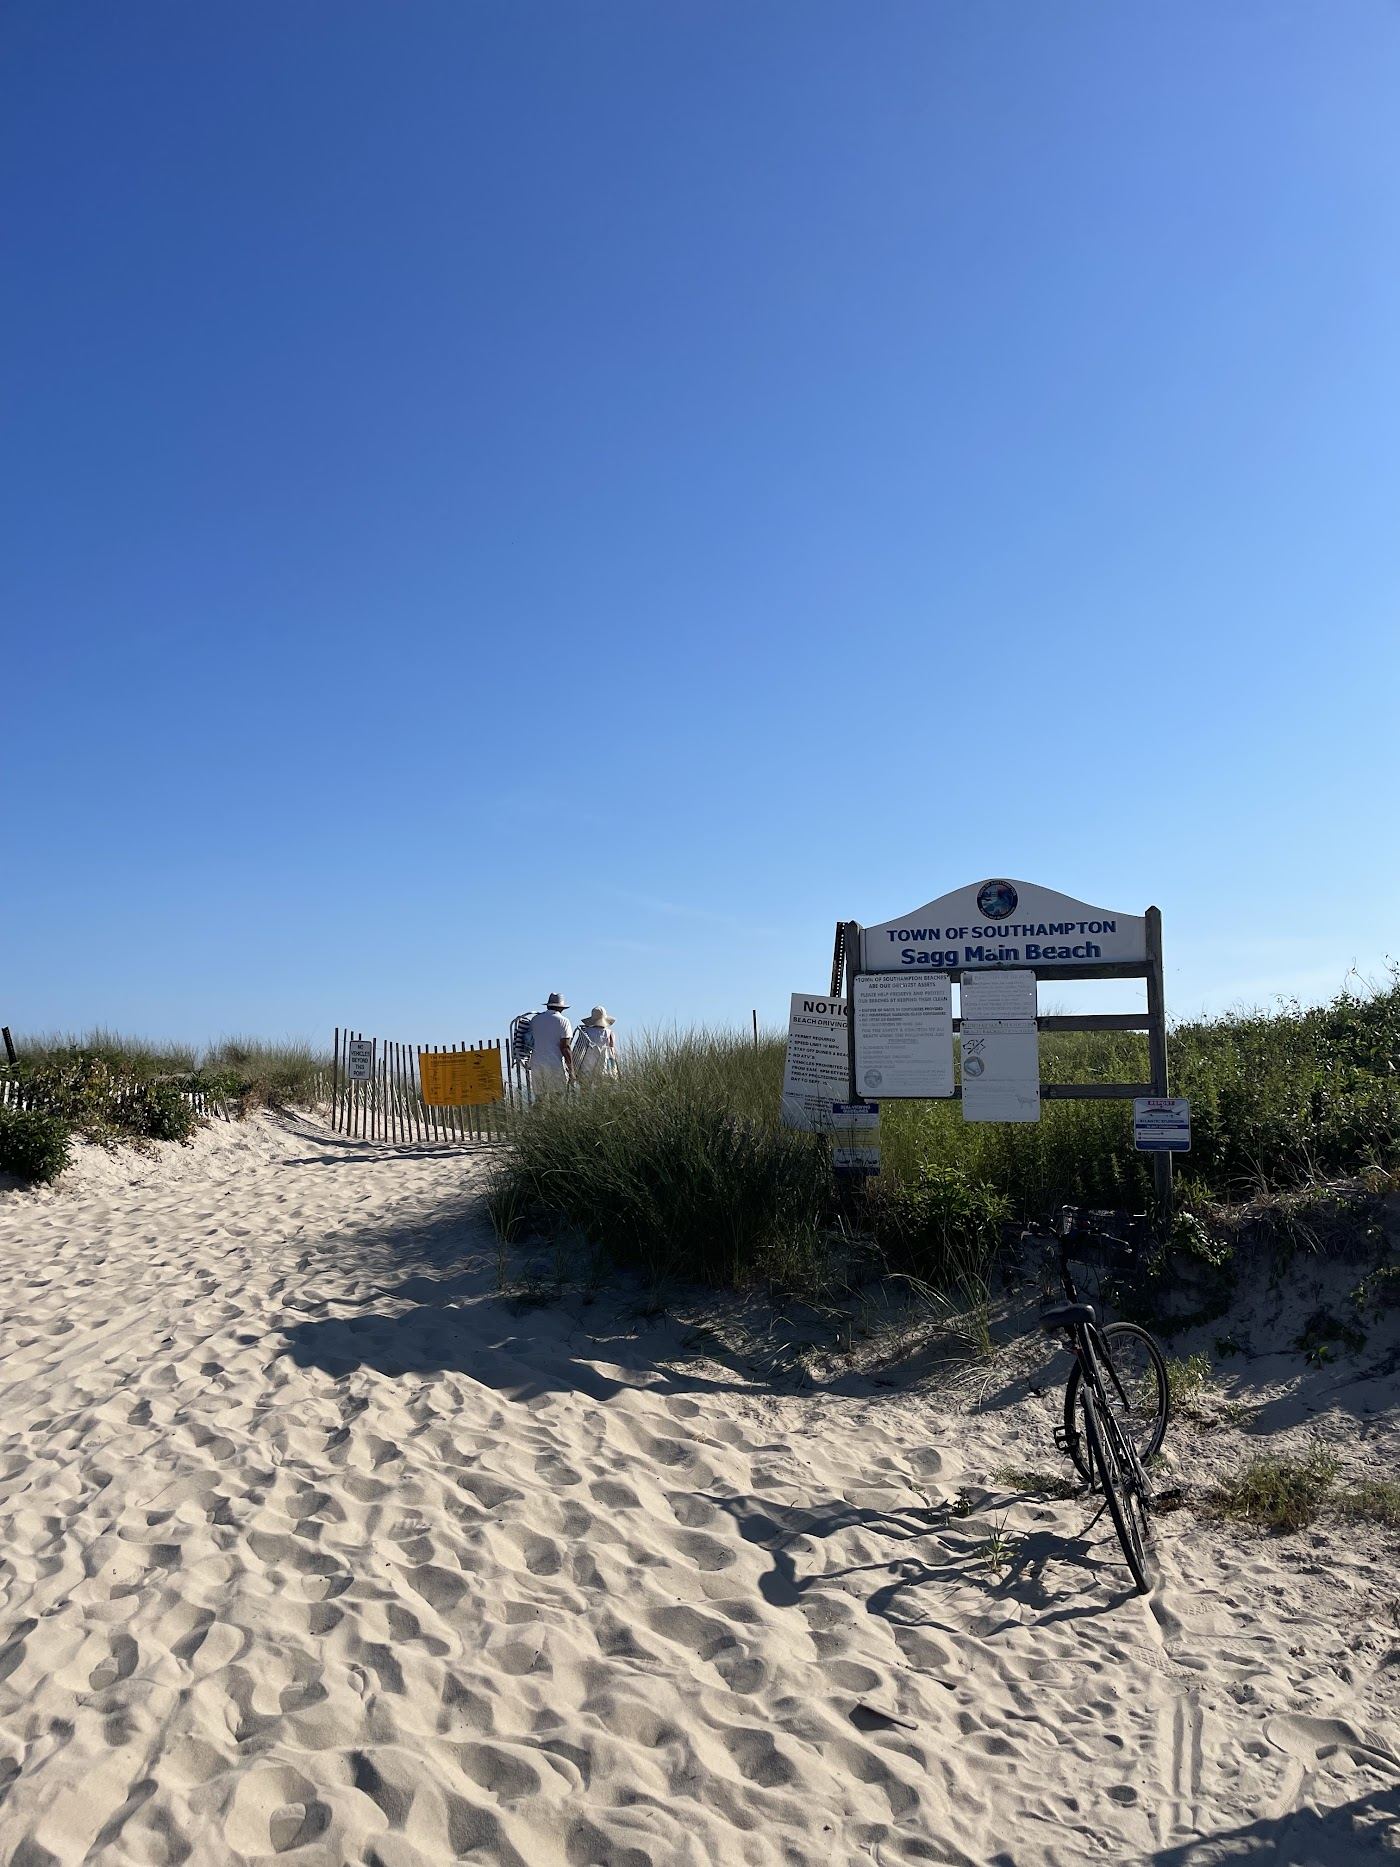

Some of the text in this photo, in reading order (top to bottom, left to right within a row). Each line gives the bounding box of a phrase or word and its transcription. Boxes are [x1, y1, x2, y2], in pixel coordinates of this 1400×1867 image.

[886, 921, 1116, 942] TOWN OF SOUTHAMPTON
[902, 941, 1100, 968] Sagg Main Beach
[818, 1020, 848, 1028] DRIVING
